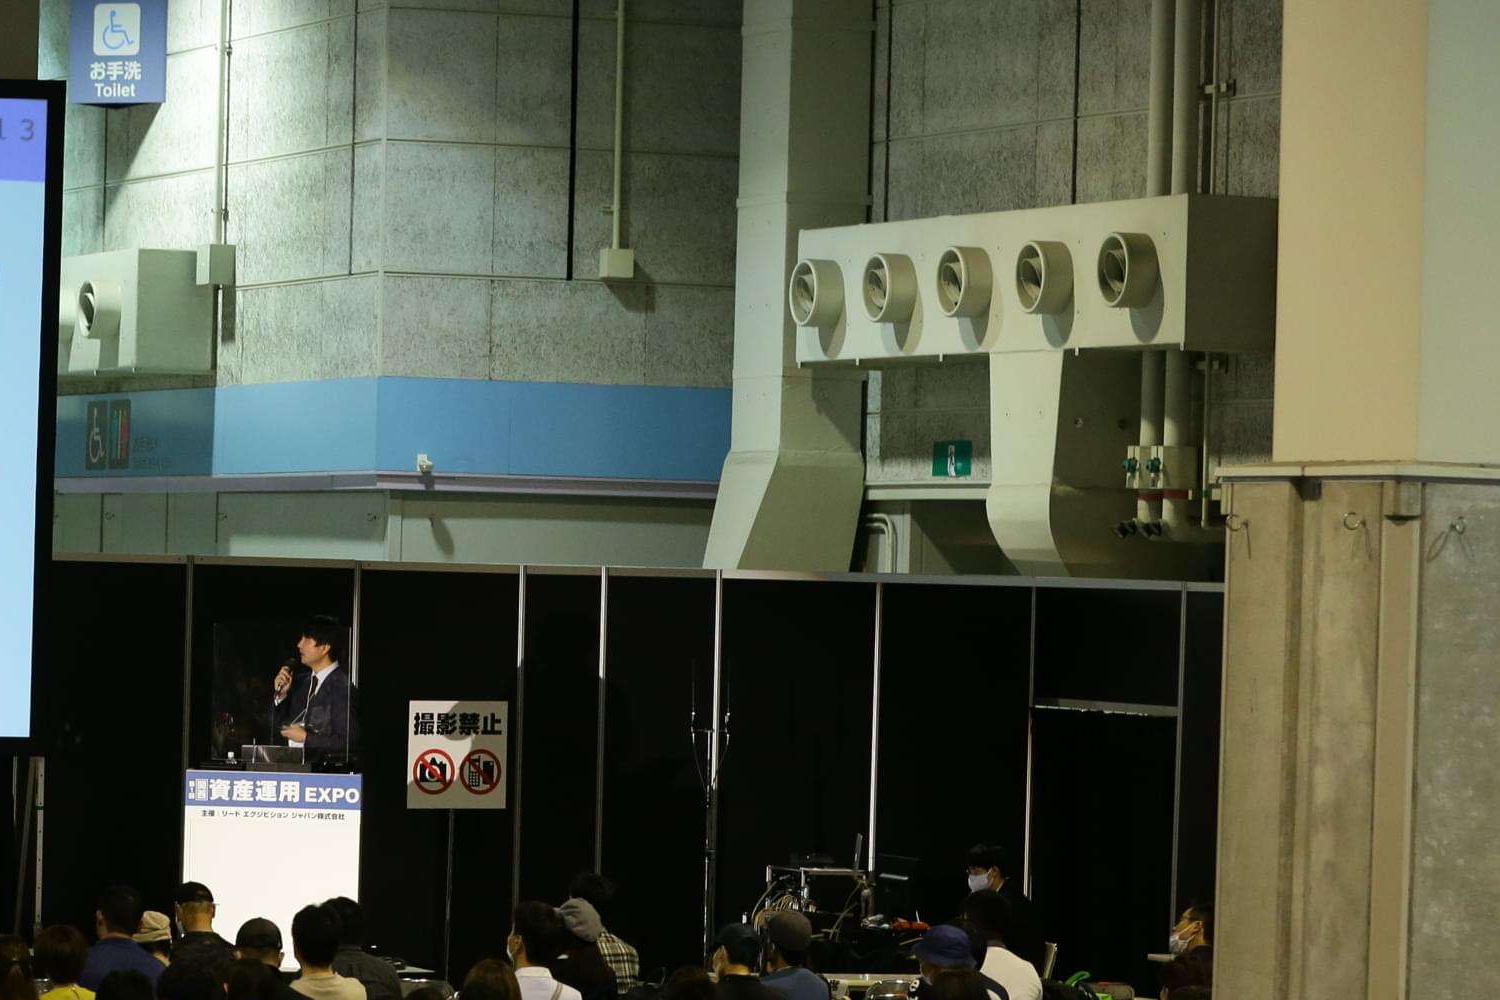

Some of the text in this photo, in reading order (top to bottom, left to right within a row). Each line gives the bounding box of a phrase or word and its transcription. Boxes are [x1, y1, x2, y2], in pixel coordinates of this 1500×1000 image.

[90, 61, 142, 81] お手洗
[94, 83, 136, 97] Toilet
[414, 712, 502, 735] 撮影禁止
[209, 779, 300, 803] 資産運用
[304, 787, 360, 804] EXPO
